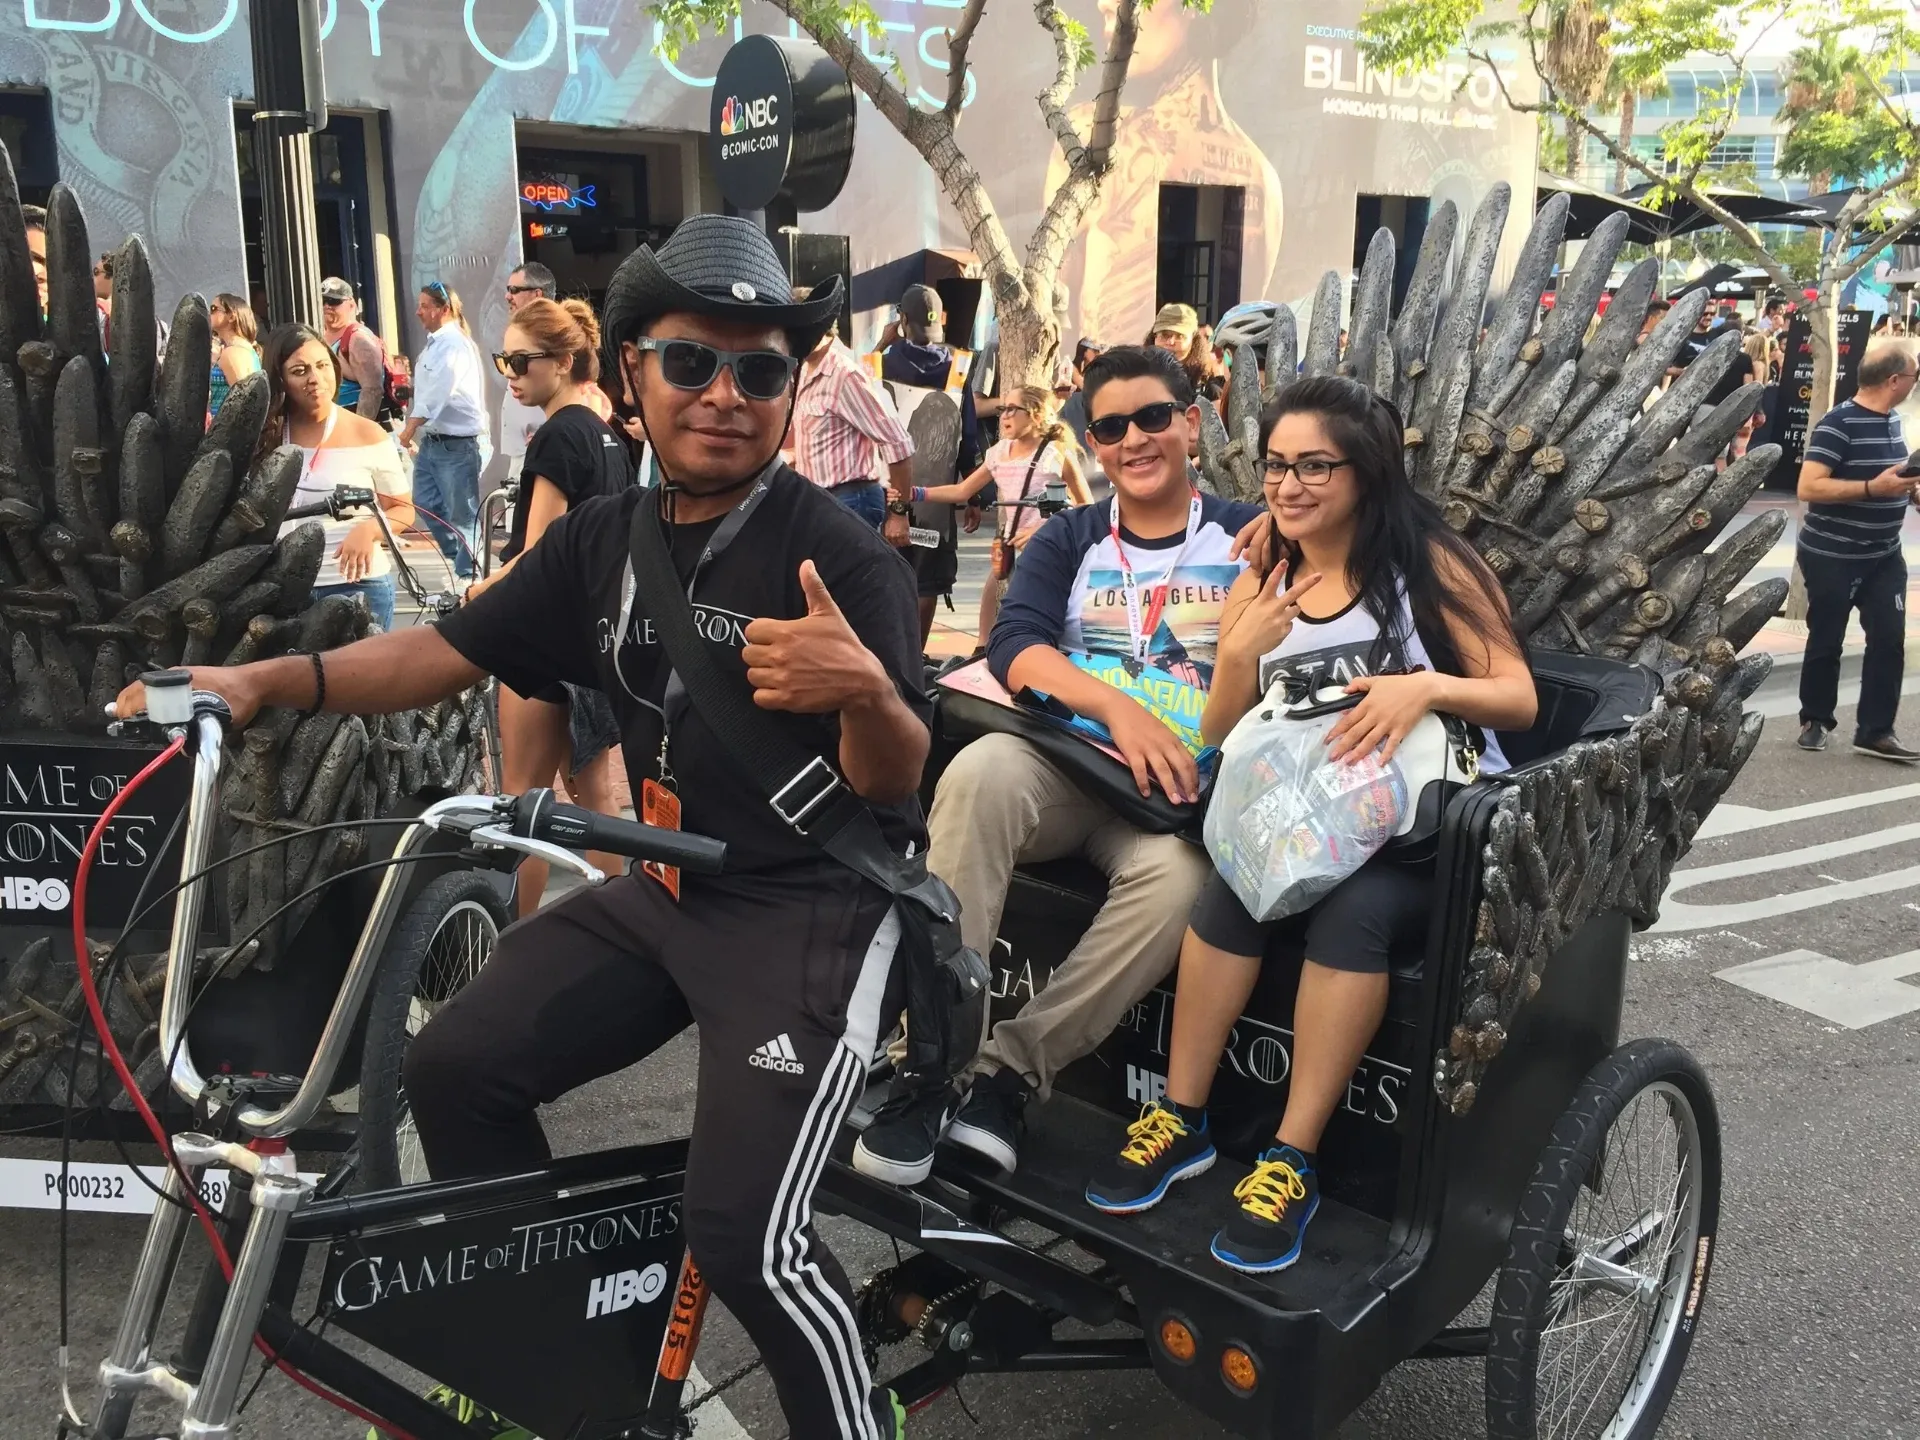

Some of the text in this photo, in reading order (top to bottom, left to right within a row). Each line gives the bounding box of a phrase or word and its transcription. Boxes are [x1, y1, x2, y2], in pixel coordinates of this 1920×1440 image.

[1306, 24, 1356, 40] EXECUTIVE
[1303, 44, 1518, 110] BLINDSPOT
[744, 94, 779, 129] NBC
[1322, 96, 1387, 119] MONDAYS
[1388, 103, 1419, 123] THIS
[1420, 106, 1452, 126] FALL
[721, 133, 779, 160] @COMIC-CON
[524, 185, 568, 201] OPEN
[1094, 585, 1232, 608] LOS AGELES
[0, 763, 80, 807] ME
[0, 876, 71, 911] HBO
[748, 1053, 805, 1075] adidas
[1126, 1063, 1168, 1108] HB
[334, 1198, 682, 1312] GAME OF THRONES
[585, 1261, 668, 1320] HBO
[667, 1268, 702, 1349] 2015
